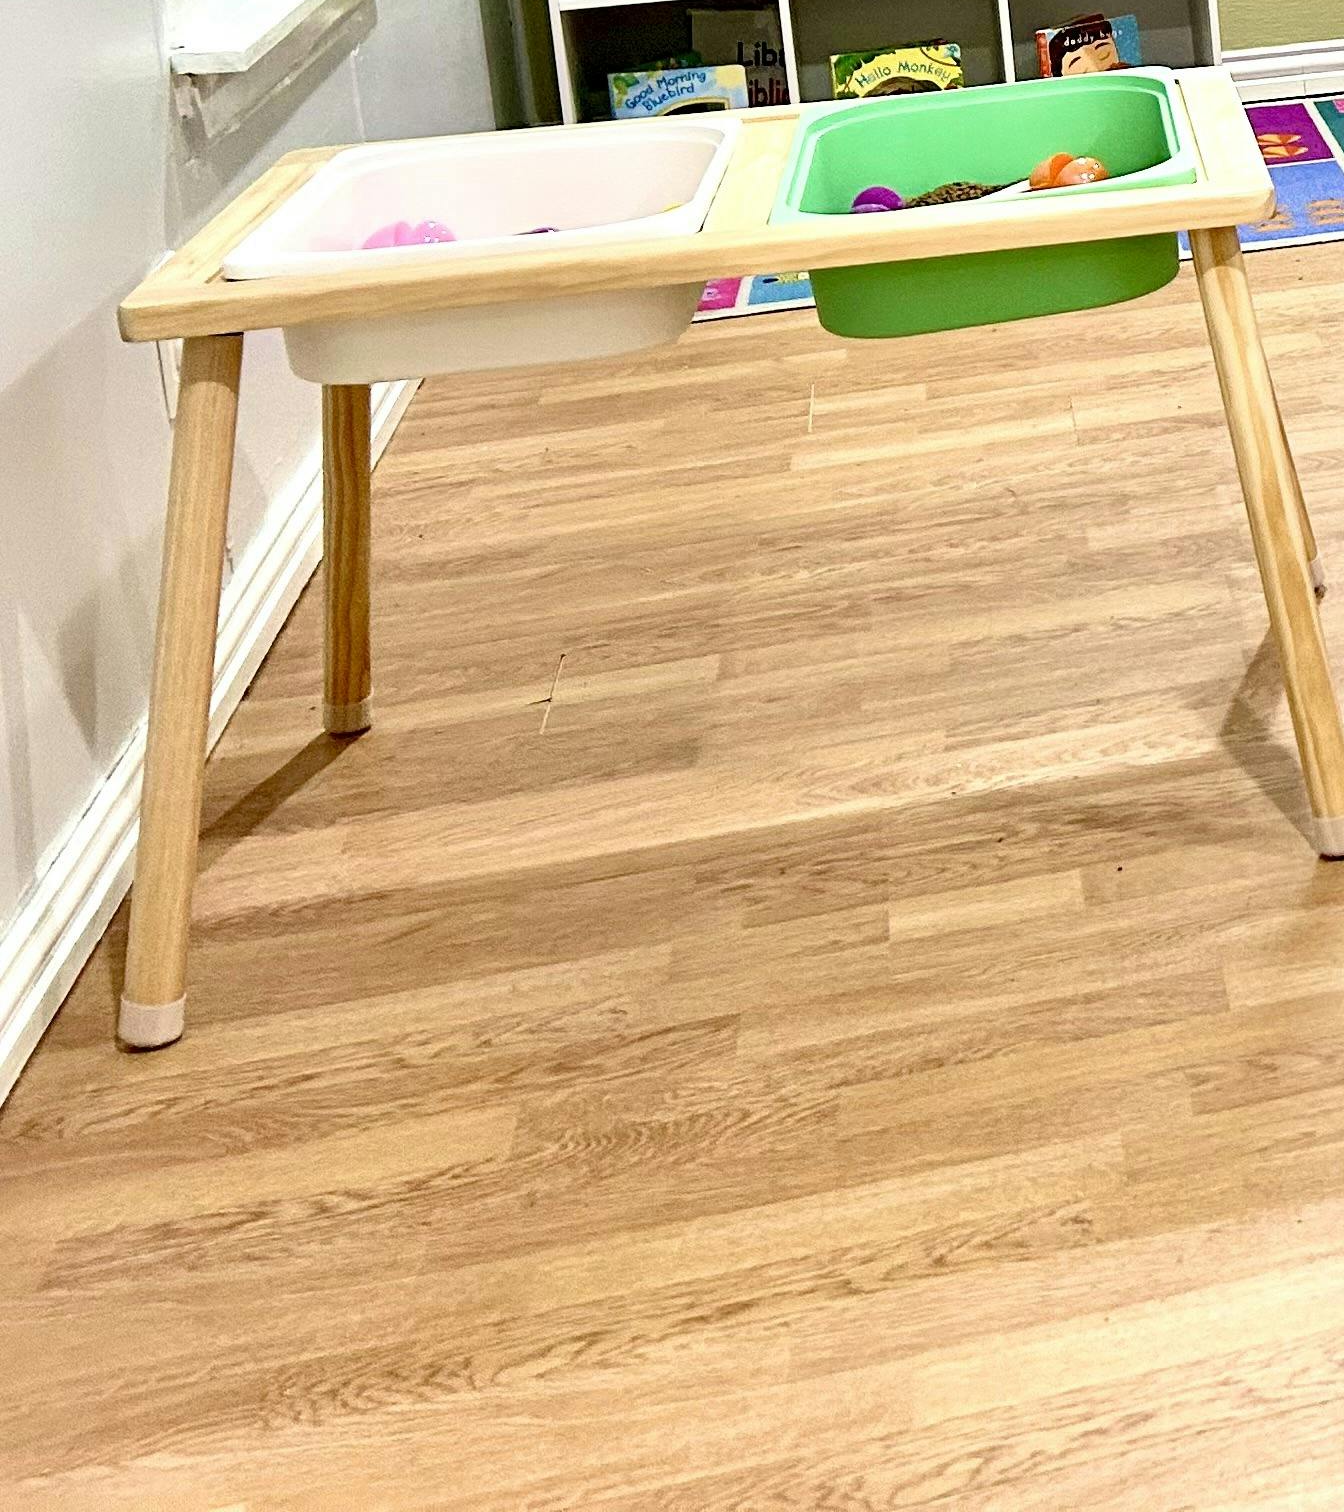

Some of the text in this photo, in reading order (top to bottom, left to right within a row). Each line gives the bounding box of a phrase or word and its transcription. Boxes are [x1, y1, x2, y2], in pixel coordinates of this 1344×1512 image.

[855, 61, 951, 88] Hello Monkey
[625, 71, 706, 109] Good Morning
[641, 83, 695, 111] Bluebird
